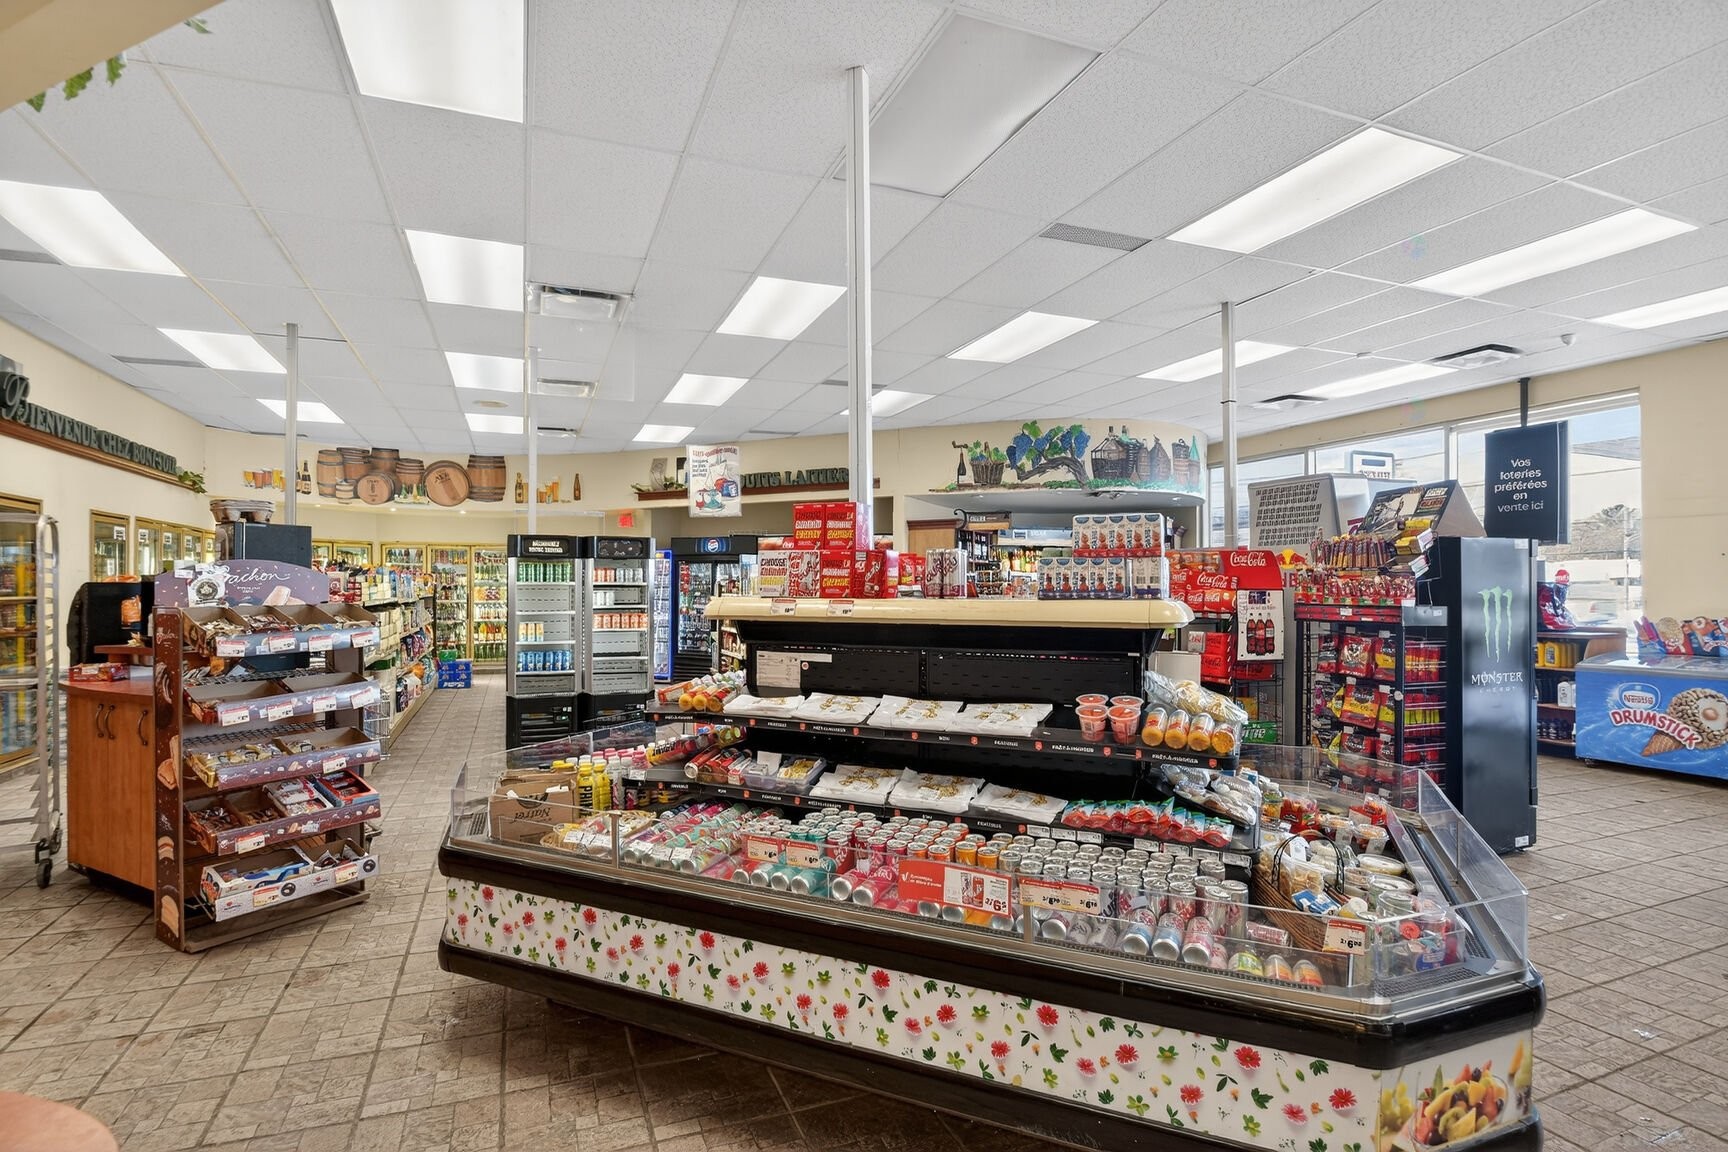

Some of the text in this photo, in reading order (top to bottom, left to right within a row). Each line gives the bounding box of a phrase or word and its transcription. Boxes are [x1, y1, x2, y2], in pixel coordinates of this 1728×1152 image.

[101, 431, 130, 460] CHEZ
[1511, 458, 1531, 468] Vos
[1500, 469, 1542, 480] loteries
[1494, 480, 1548, 493] préférées
[1513, 492, 1528, 501] en
[1497, 500, 1544, 513] vente ici
[1471, 671, 1523, 686] MONSTER
[1610, 709, 1702, 750] DRUMSTICK
